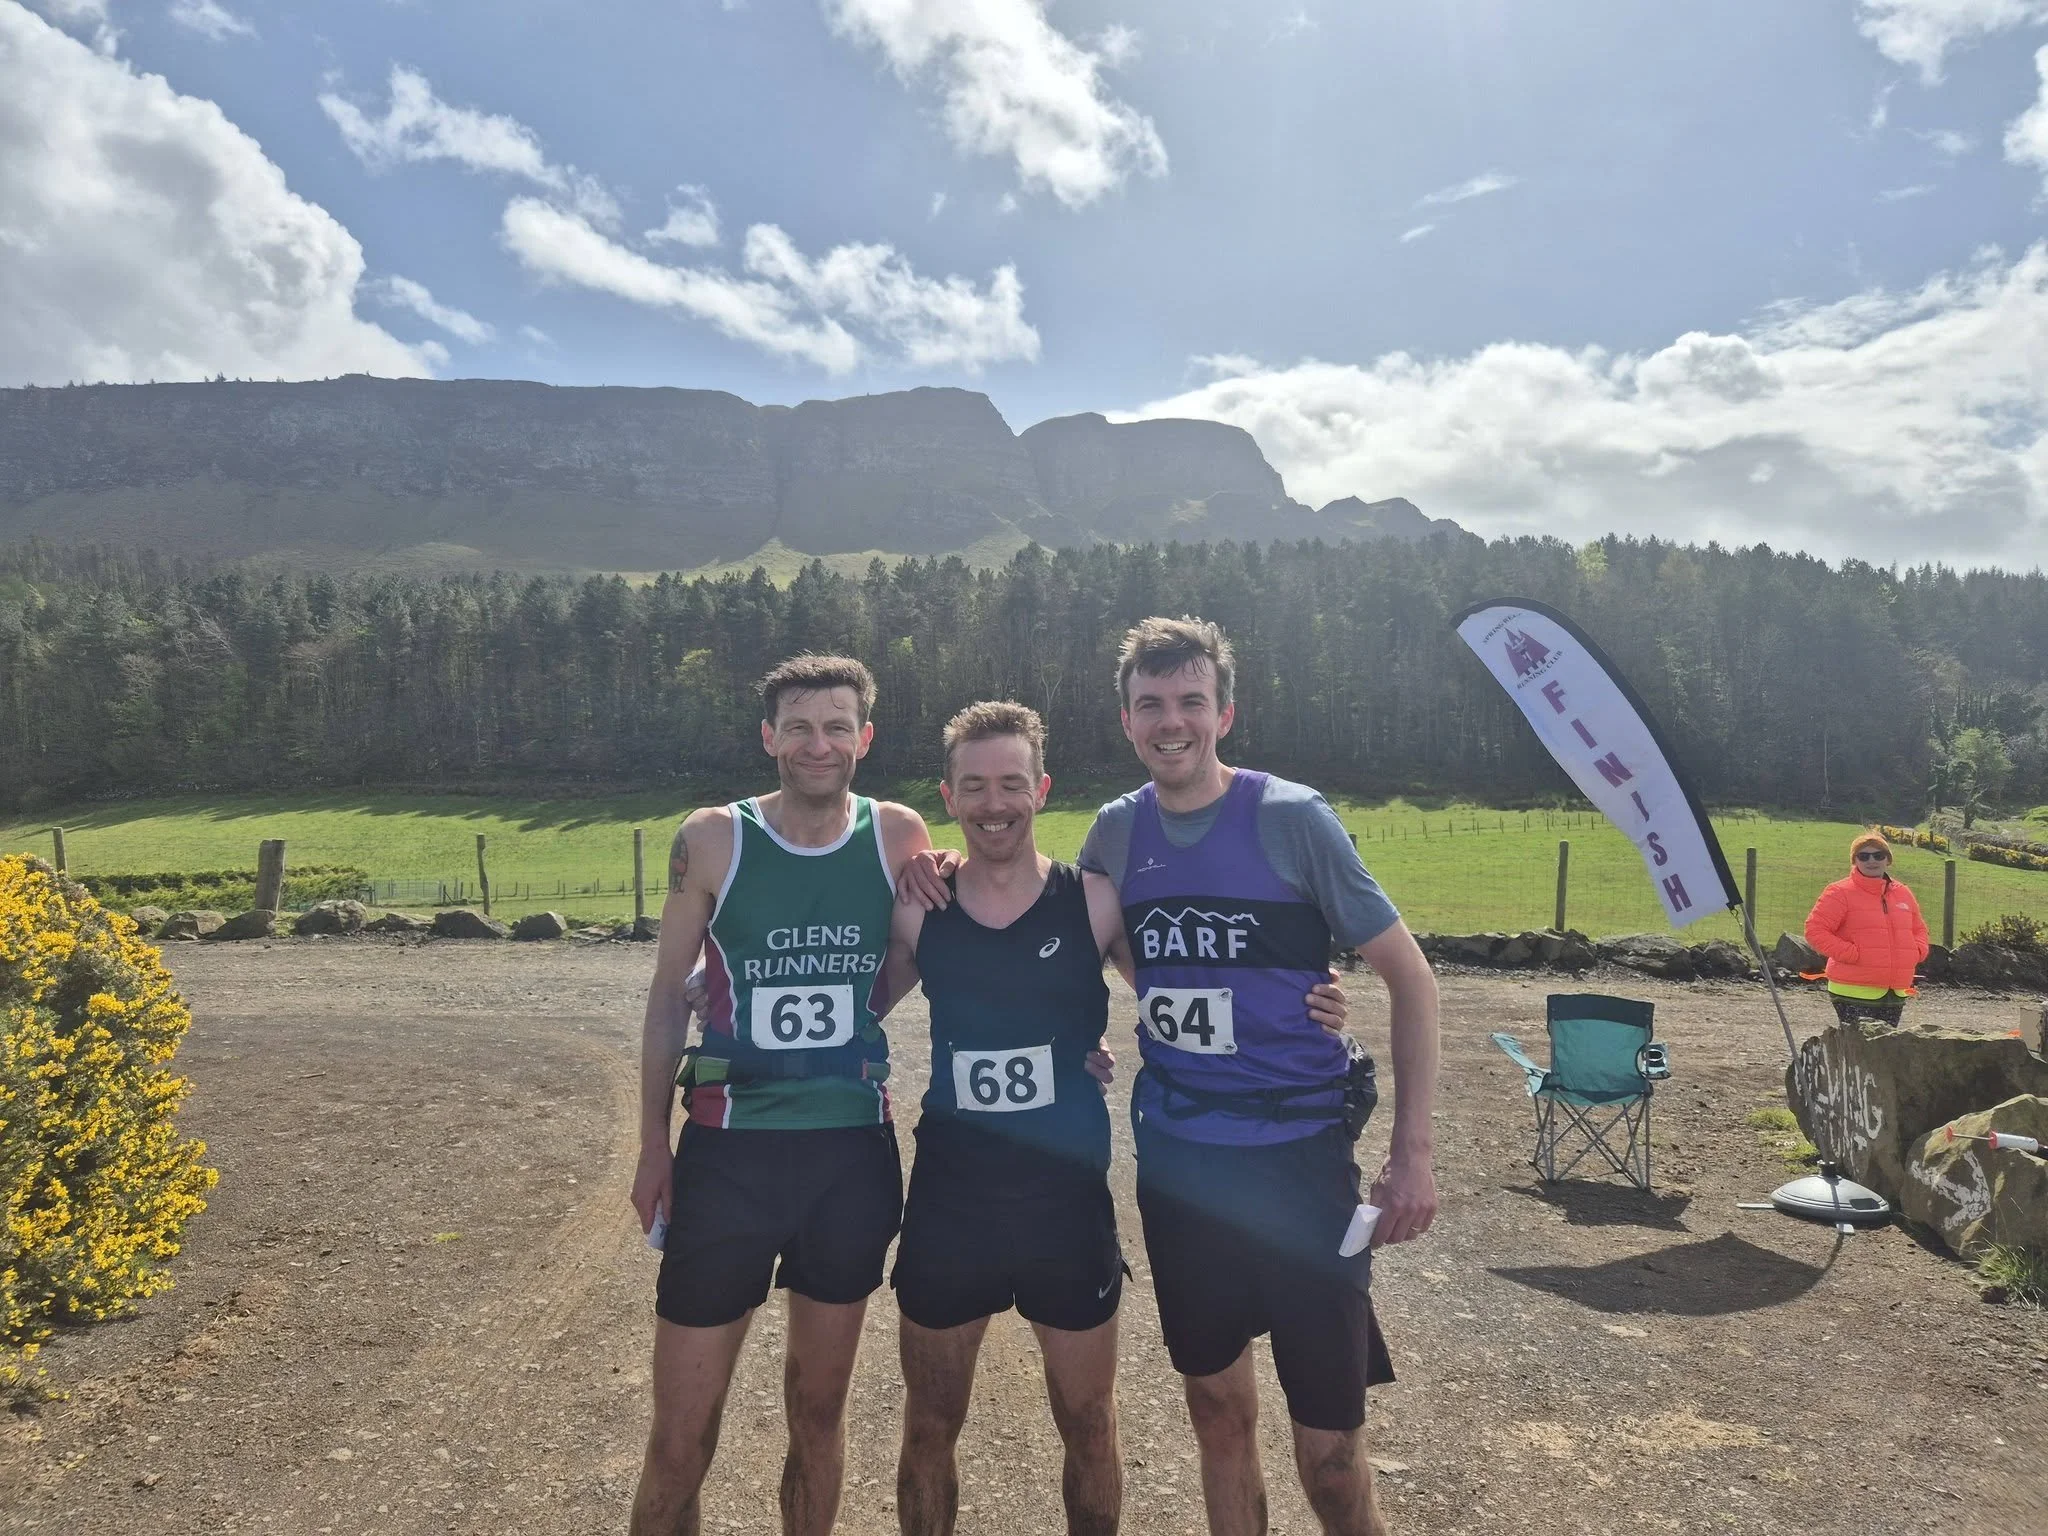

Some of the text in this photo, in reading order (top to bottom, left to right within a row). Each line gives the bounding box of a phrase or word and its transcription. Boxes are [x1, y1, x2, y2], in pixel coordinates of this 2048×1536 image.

[1516, 650, 1563, 690] RUNNING CLUB
[1541, 680, 1692, 912] FINISH
[766, 925, 861, 950] GLENS
[1143, 926, 1248, 959] BARF
[744, 953, 877, 980] RUNNERS
[770, 993, 836, 1042] 63
[1149, 995, 1215, 1046] 64
[969, 1056, 1037, 1105] 68
